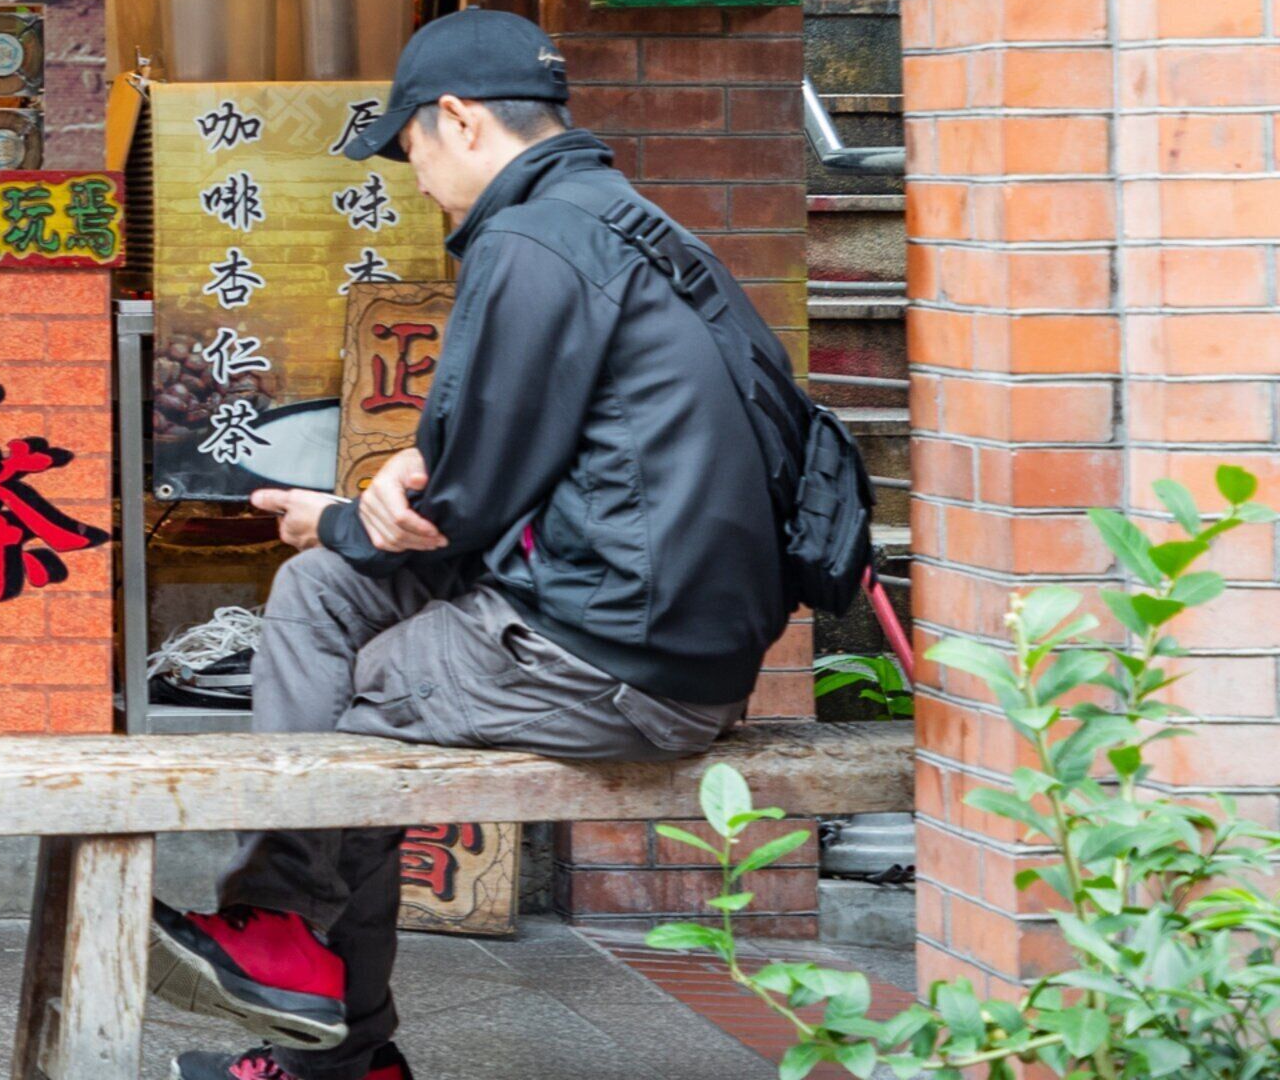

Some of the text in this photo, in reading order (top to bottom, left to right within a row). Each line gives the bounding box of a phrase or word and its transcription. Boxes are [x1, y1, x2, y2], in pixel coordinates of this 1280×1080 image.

[197, 102, 271, 463] 咖啡杏仁茶
